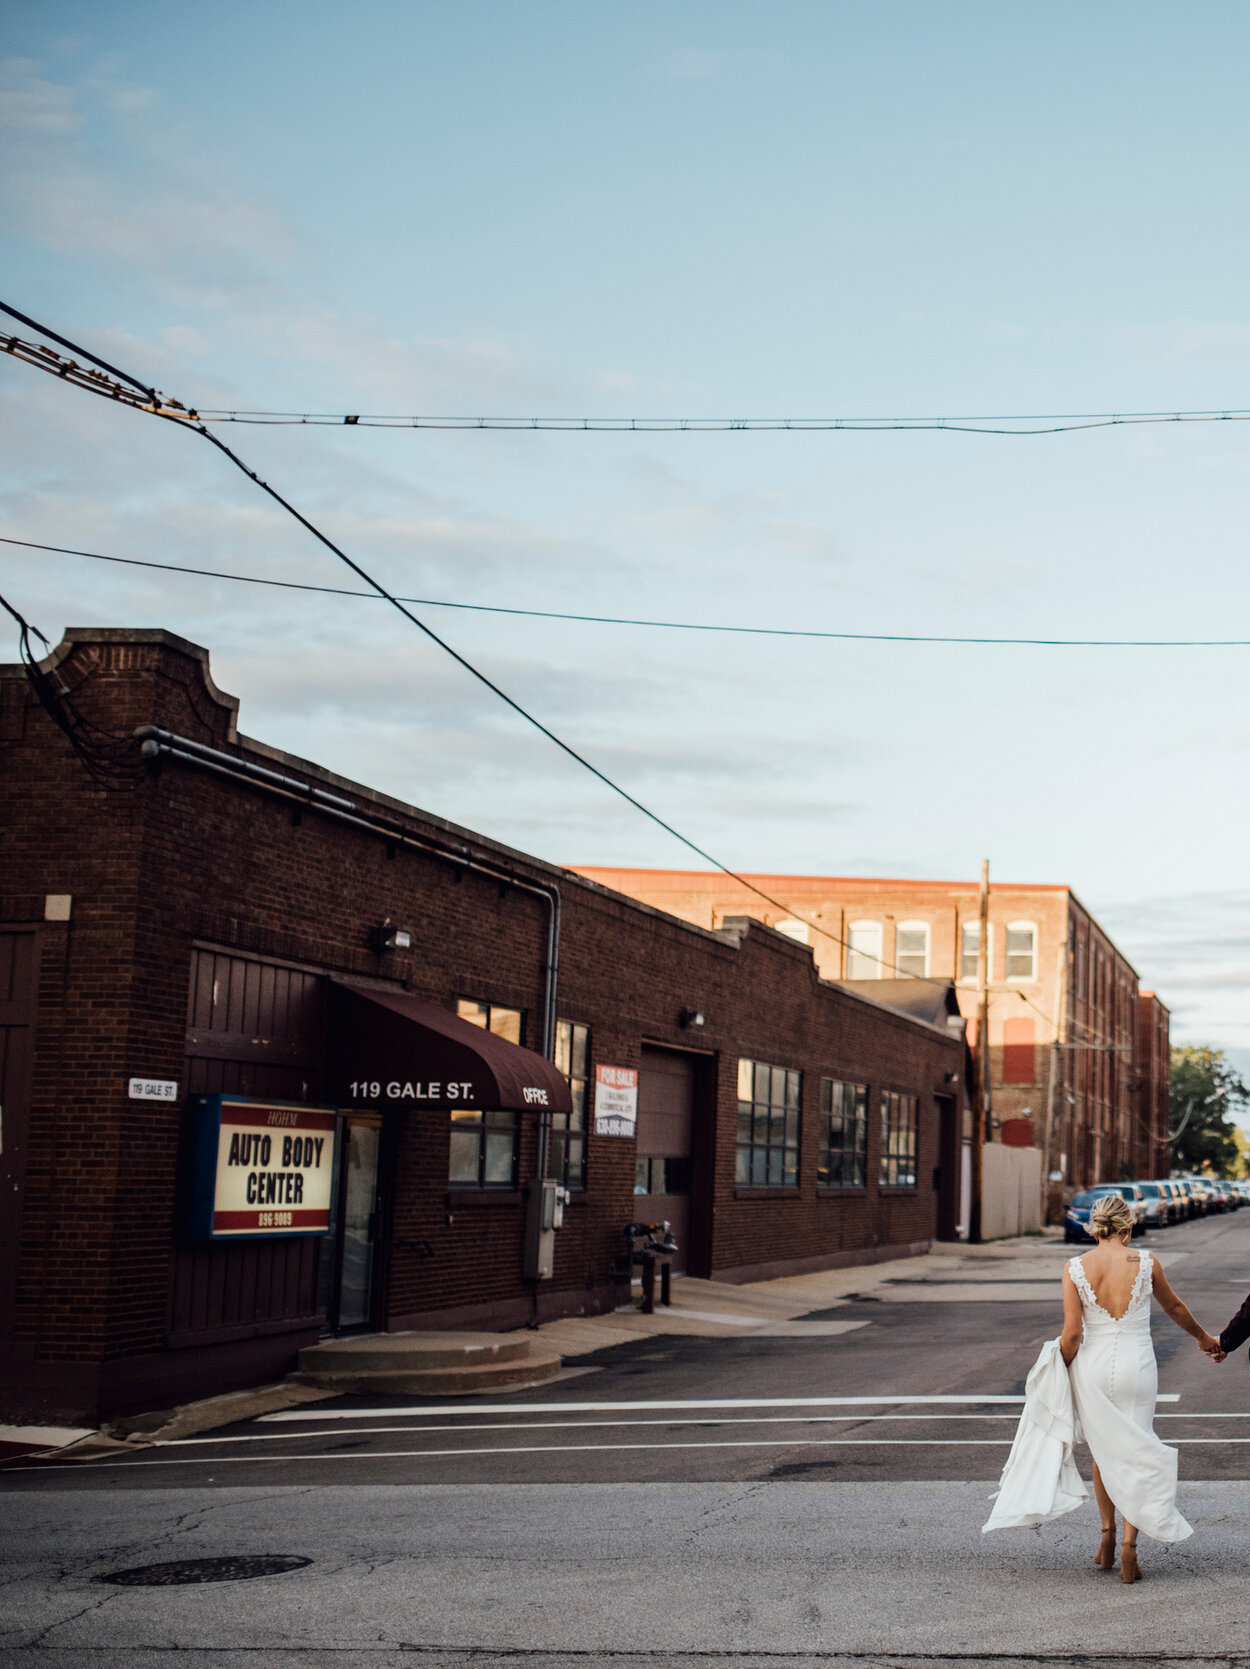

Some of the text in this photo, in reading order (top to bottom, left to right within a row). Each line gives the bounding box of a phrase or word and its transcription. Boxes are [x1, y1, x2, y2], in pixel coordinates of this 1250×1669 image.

[601, 1067, 634, 1086] FOR SALE
[145, 1084, 162, 1096] GALE
[350, 1082, 474, 1099] 119 GALE ST.
[523, 1087, 549, 1105] OFFICE
[228, 1132, 325, 1168] AUTO BODY
[247, 1172, 304, 1204] CENTER
